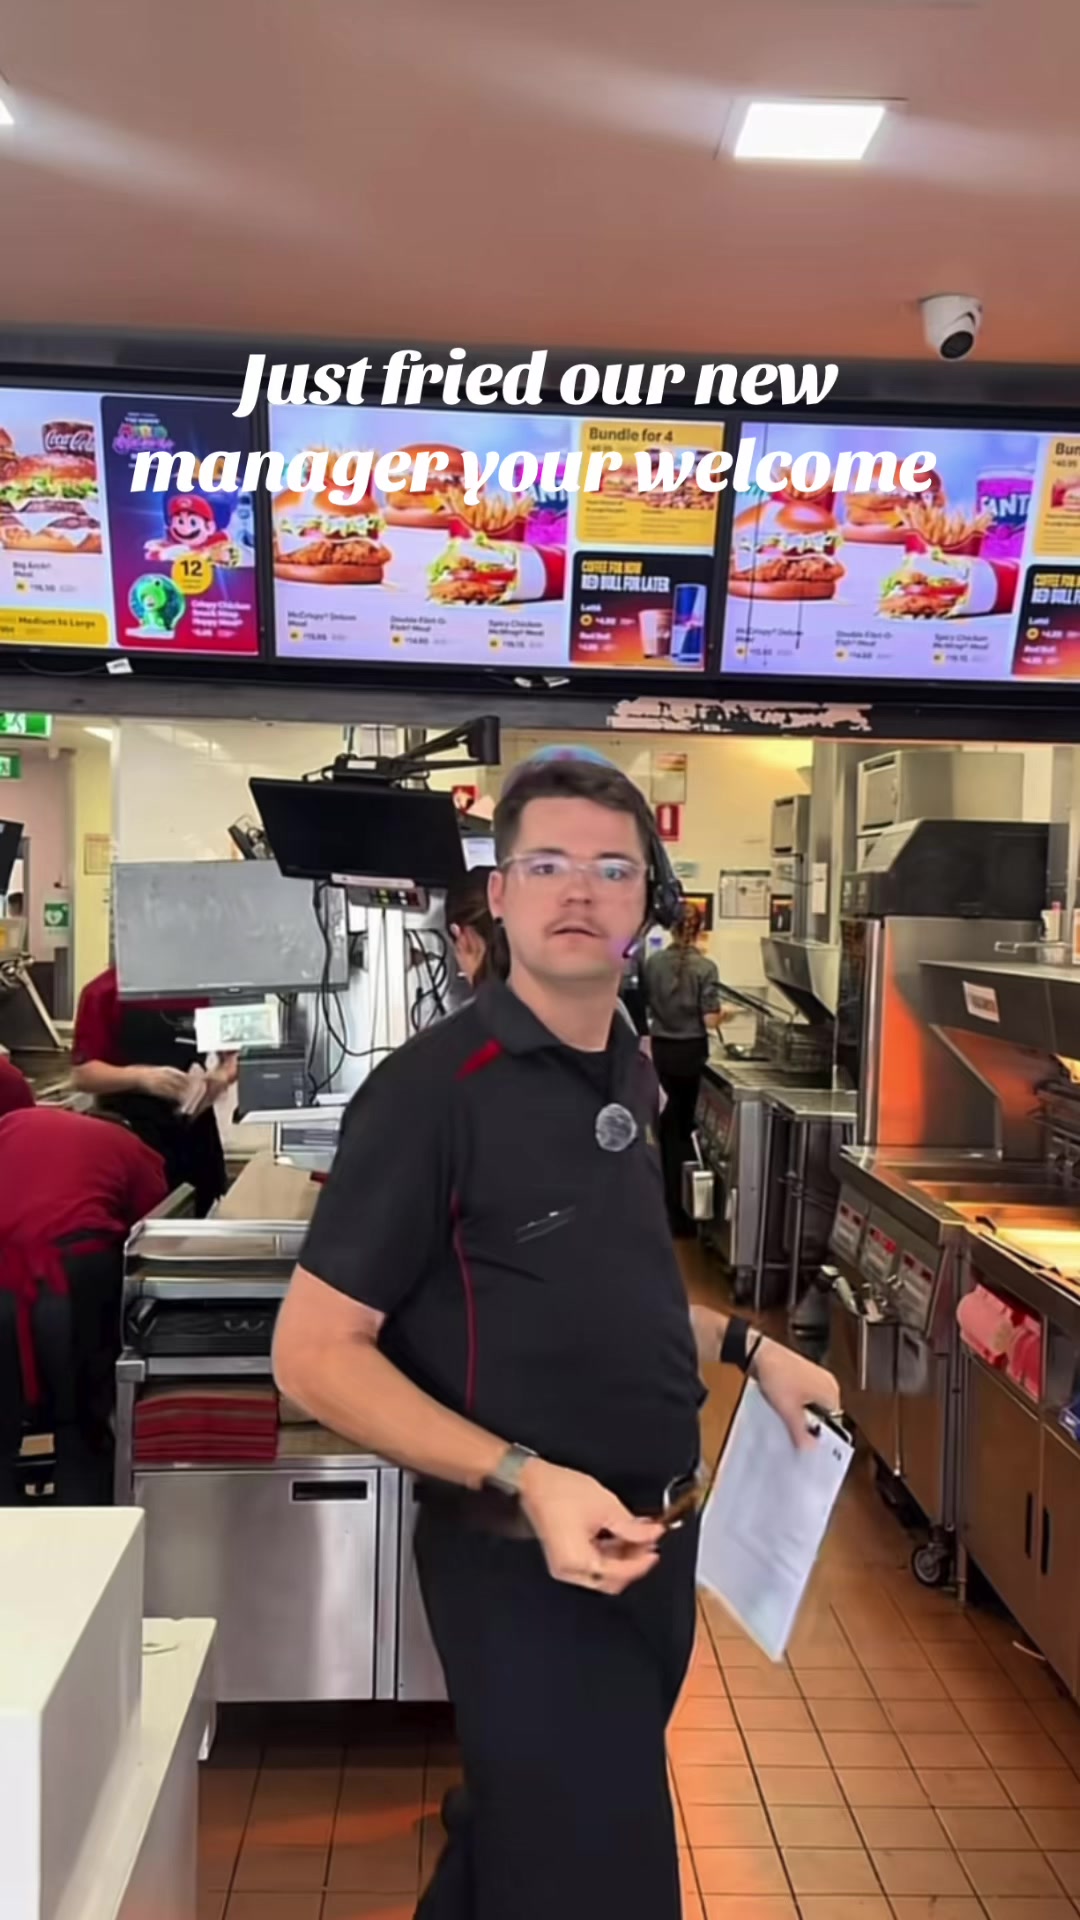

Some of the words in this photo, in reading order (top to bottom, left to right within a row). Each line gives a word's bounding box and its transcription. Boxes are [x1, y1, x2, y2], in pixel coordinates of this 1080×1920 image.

[589, 427, 639, 441] Bundle
[641, 429, 662, 442] for
[664, 431, 674, 442] 4
[180, 560, 203, 577] 12
[581, 574, 599, 590] RED
[600, 574, 622, 591] BULL
[622, 575, 641, 592] FOR
[641, 576, 670, 593] LATER
[1031, 588, 1050, 604] RED
[1050, 588, 1073, 604] BULL
[19, 616, 56, 625] Medium
[70, 618, 96, 629] Large
